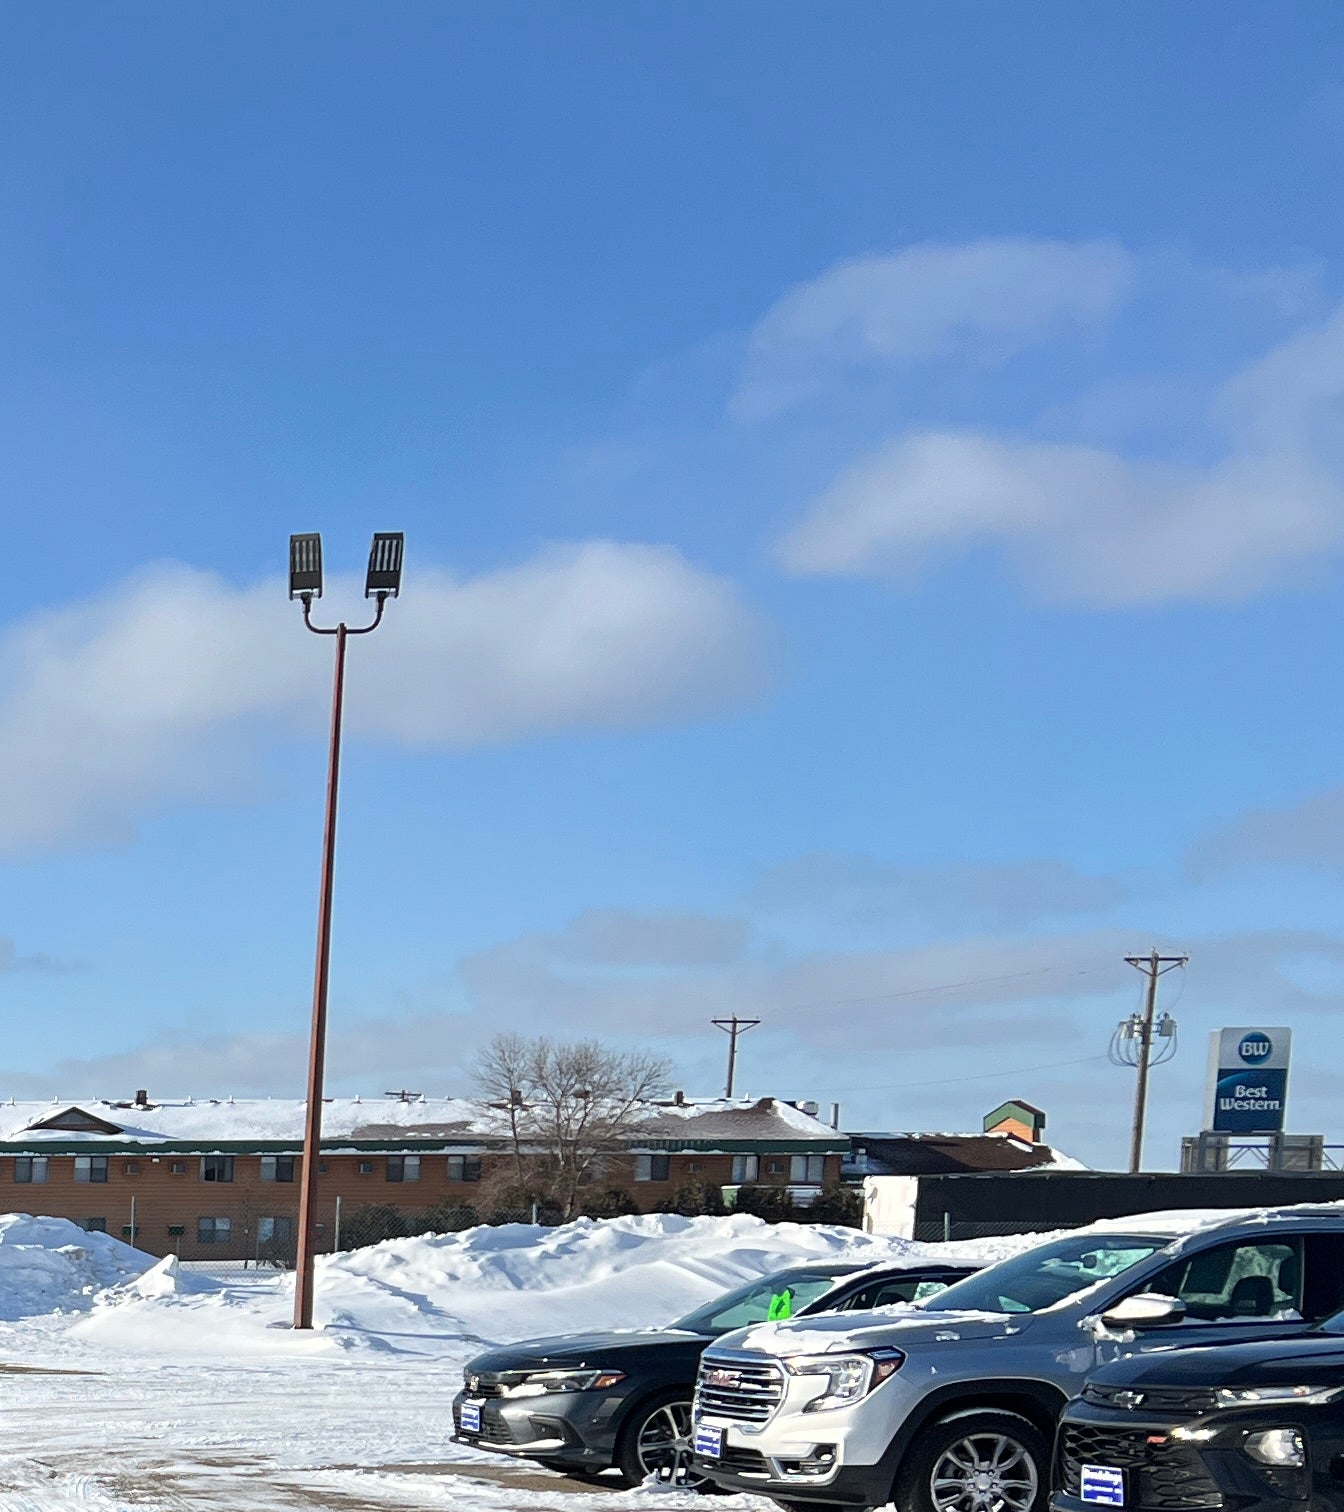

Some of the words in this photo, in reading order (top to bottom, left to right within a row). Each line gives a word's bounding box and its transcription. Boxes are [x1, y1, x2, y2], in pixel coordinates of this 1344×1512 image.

[1241, 1042, 1269, 1056] BW
[1235, 1085, 1268, 1098] Best
[1219, 1098, 1280, 1110] Western
